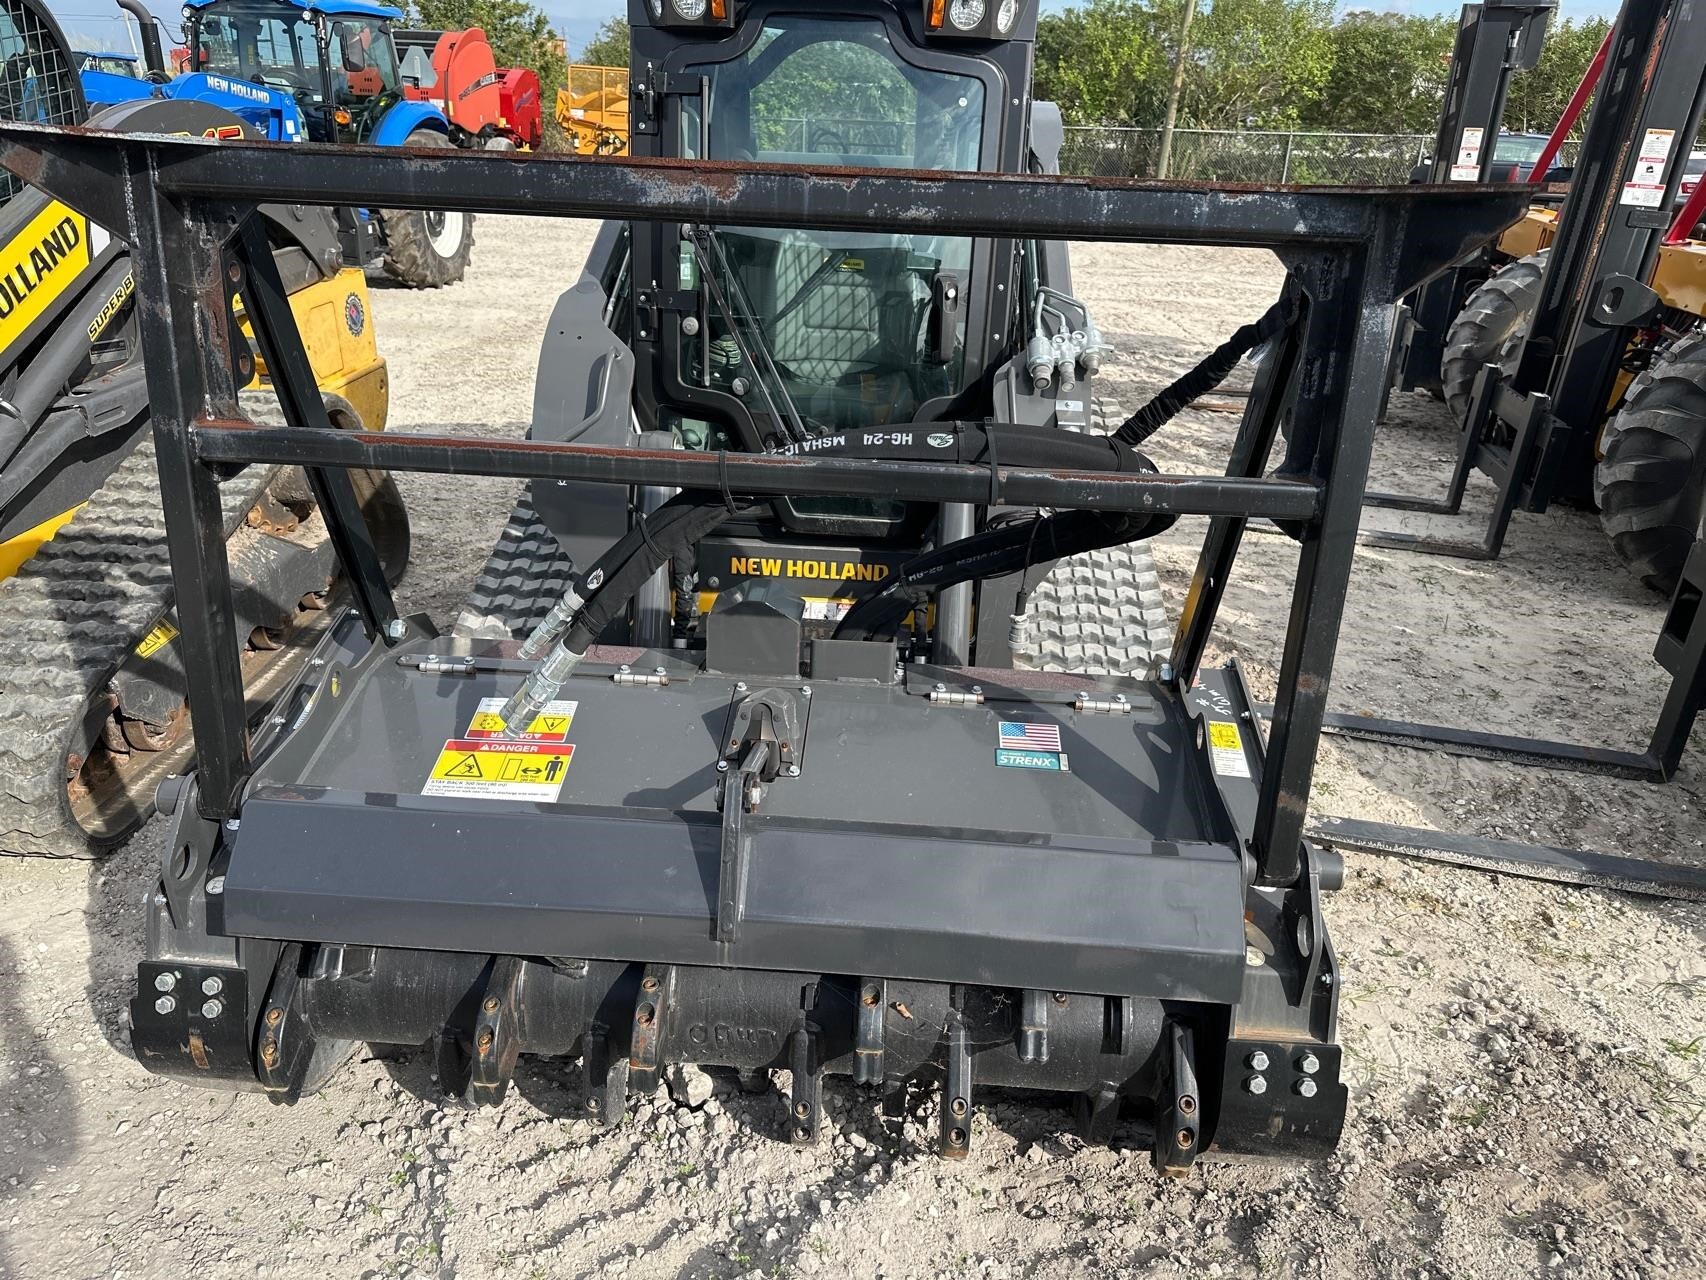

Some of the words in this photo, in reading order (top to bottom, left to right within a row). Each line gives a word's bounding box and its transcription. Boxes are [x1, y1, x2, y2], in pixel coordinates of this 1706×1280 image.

[206, 75, 229, 92] NEW
[230, 81, 270, 104] HOLLAND
[88, 287, 125, 339] SUPER
[802, 434, 845, 452] MSHA
[863, 432, 913, 446] HG-24
[731, 557, 782, 577] NEW
[786, 559, 889, 582] HOLLAND
[491, 744, 539, 752] DANGER
